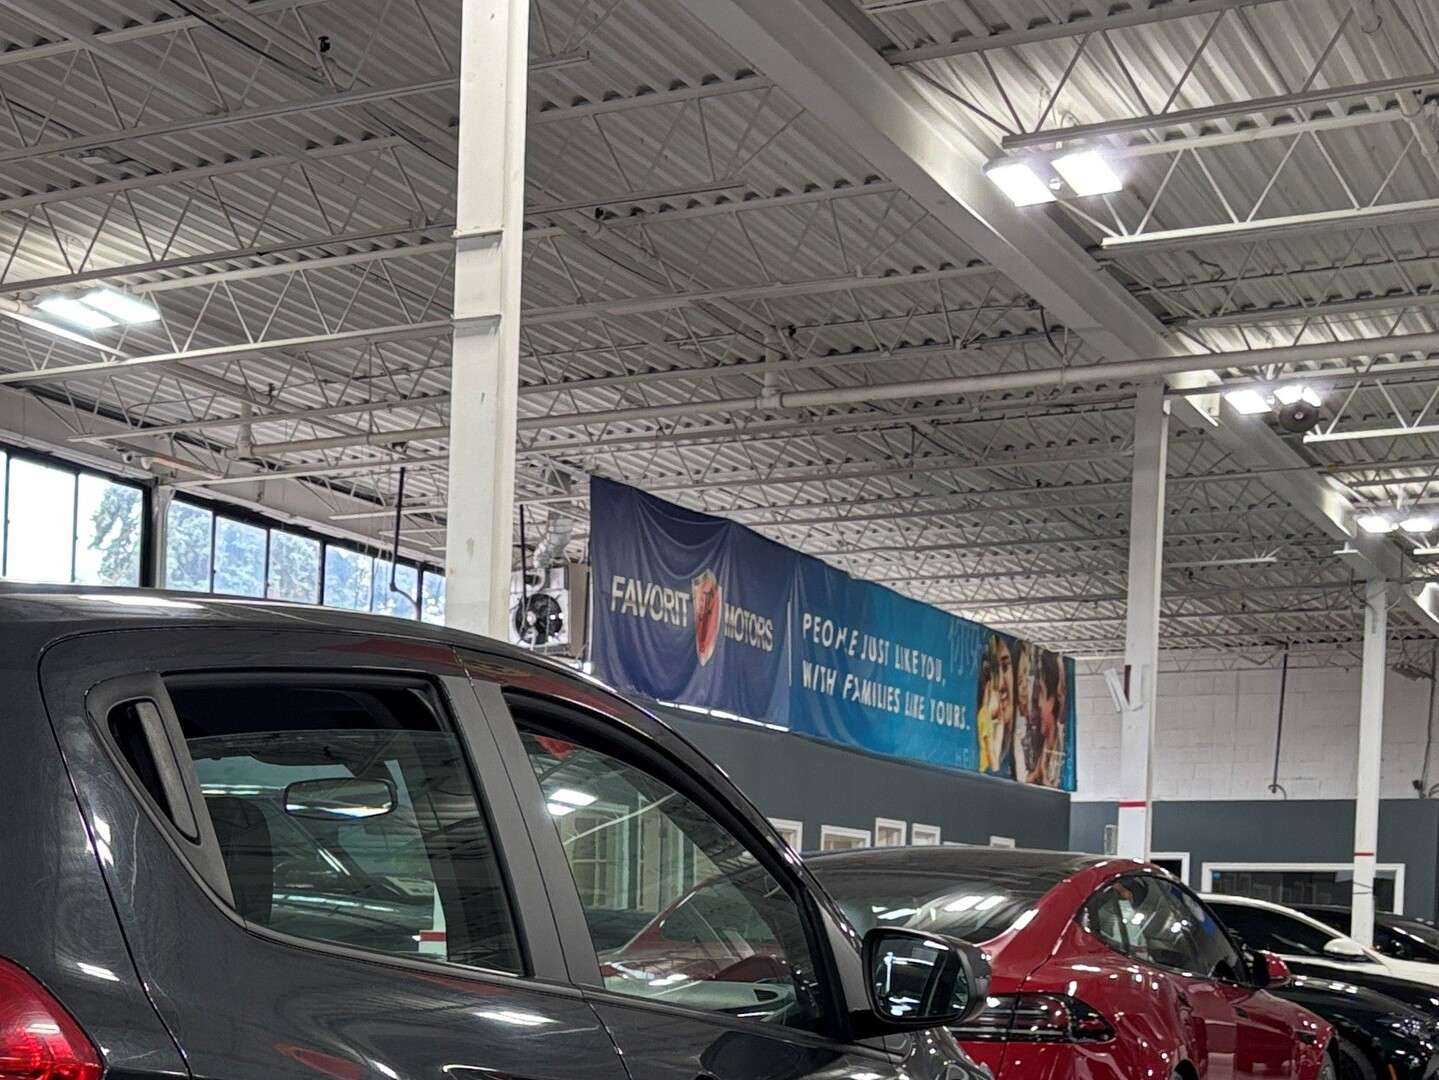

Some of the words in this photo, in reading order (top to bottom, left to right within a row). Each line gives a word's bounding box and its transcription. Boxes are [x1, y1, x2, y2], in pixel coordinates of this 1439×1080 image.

[611, 575, 690, 627] FAVORIT
[724, 603, 773, 651] MOTORS
[861, 634, 890, 666] JUST
[895, 644, 918, 675] LIKE
[802, 660, 837, 696] WITH
[904, 691, 925, 720] LIKE
[929, 699, 971, 731] YOURS.
